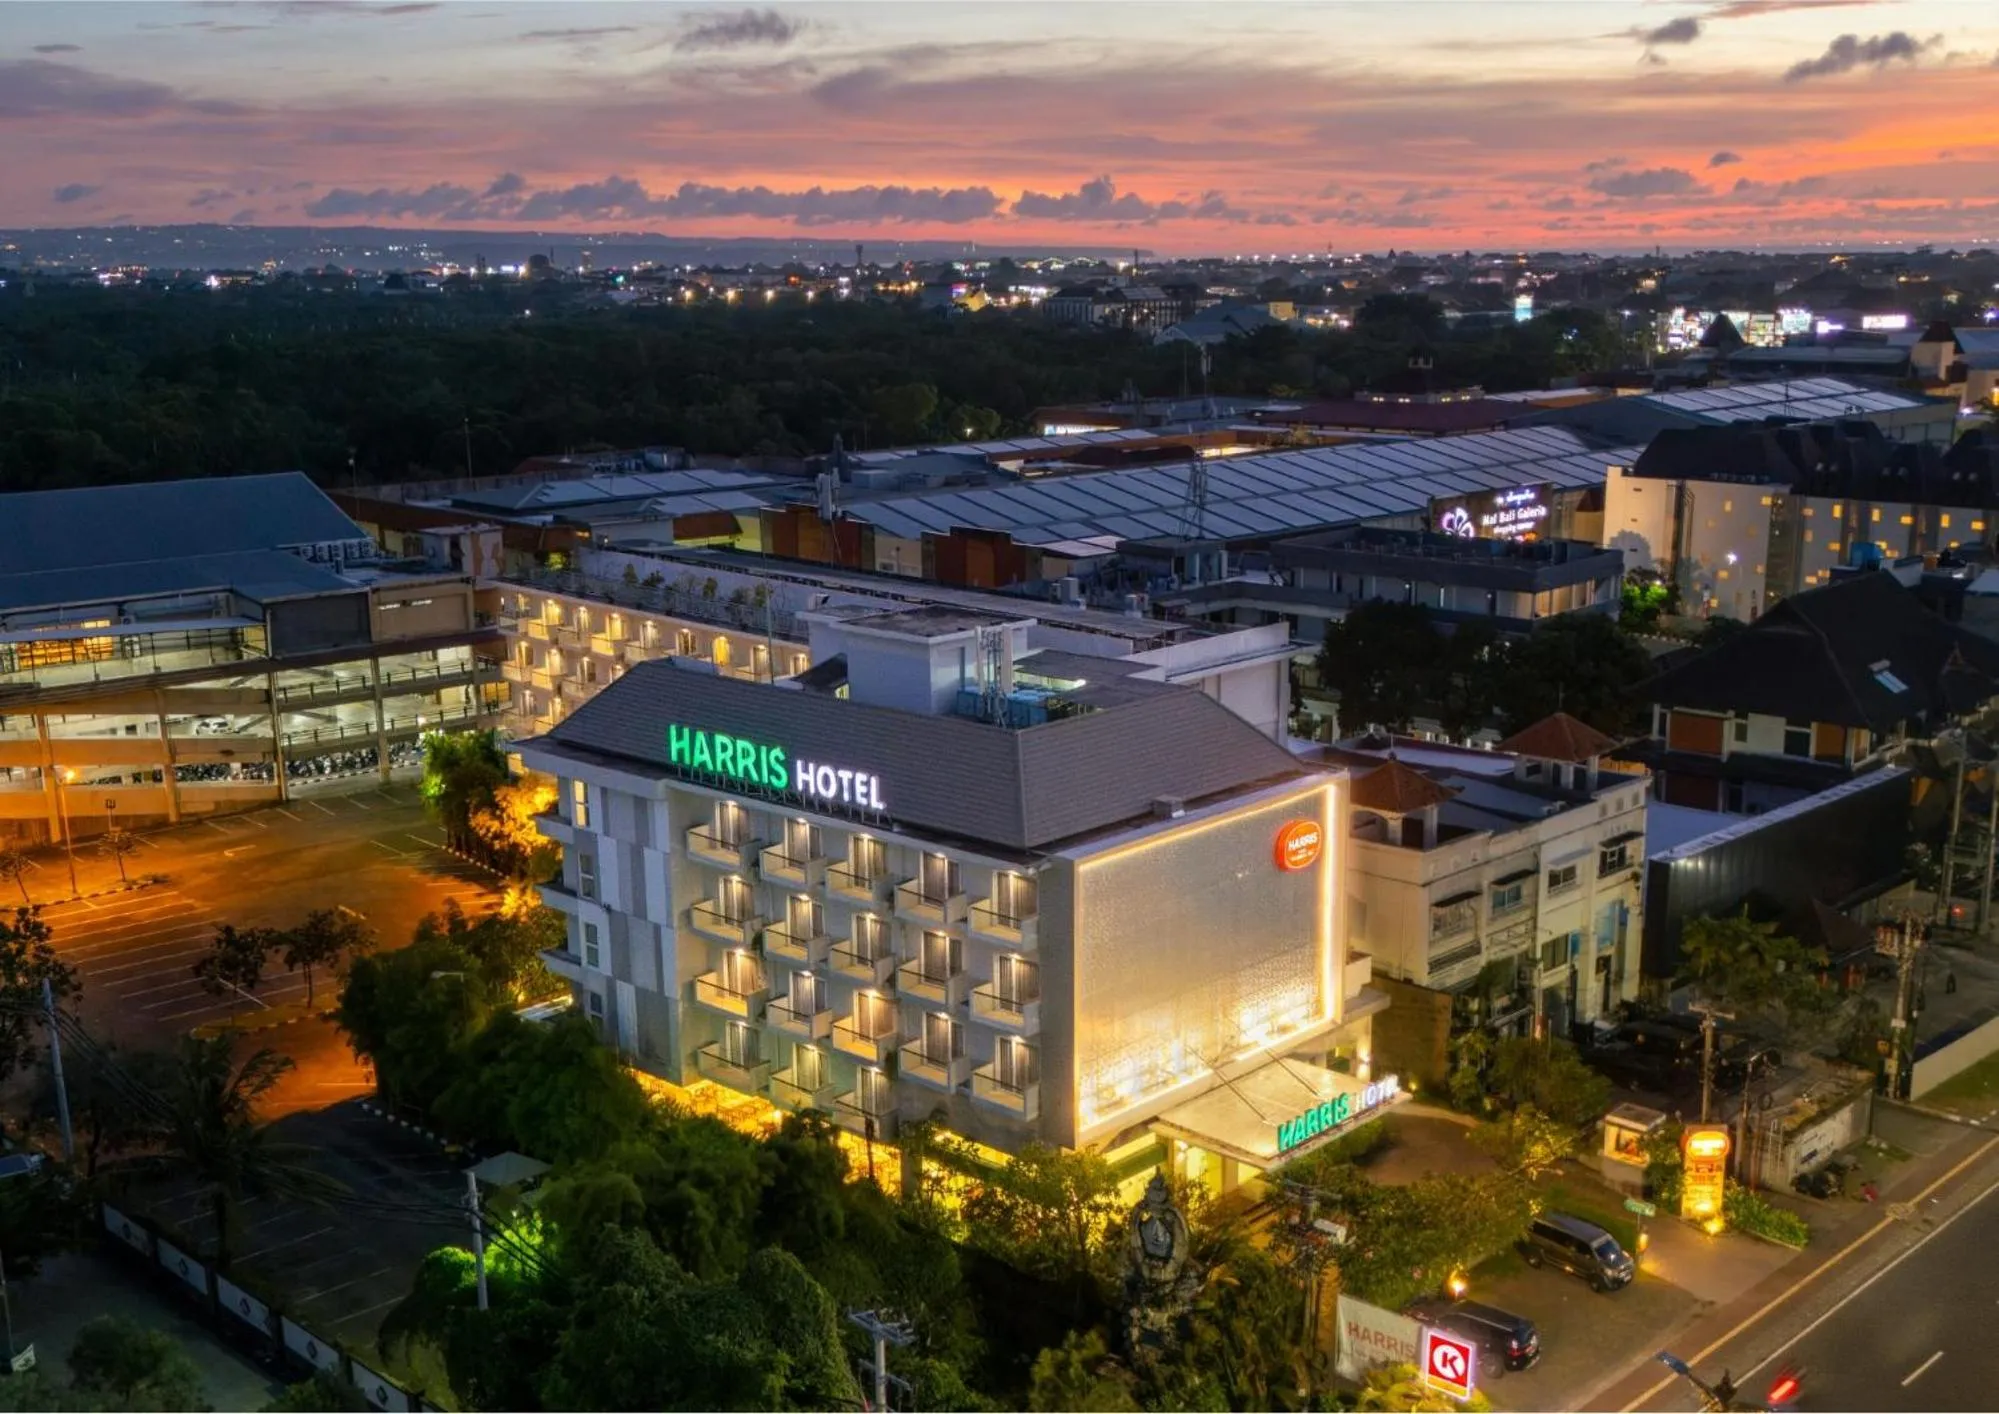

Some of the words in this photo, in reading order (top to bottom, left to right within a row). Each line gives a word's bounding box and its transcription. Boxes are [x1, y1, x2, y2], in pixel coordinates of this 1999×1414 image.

[669, 724, 789, 788] HARRIS
[796, 759, 886, 810] HOTEL
[1277, 1092, 1350, 1152] HARRIS
[1347, 1320, 1416, 1359] HARRIS
